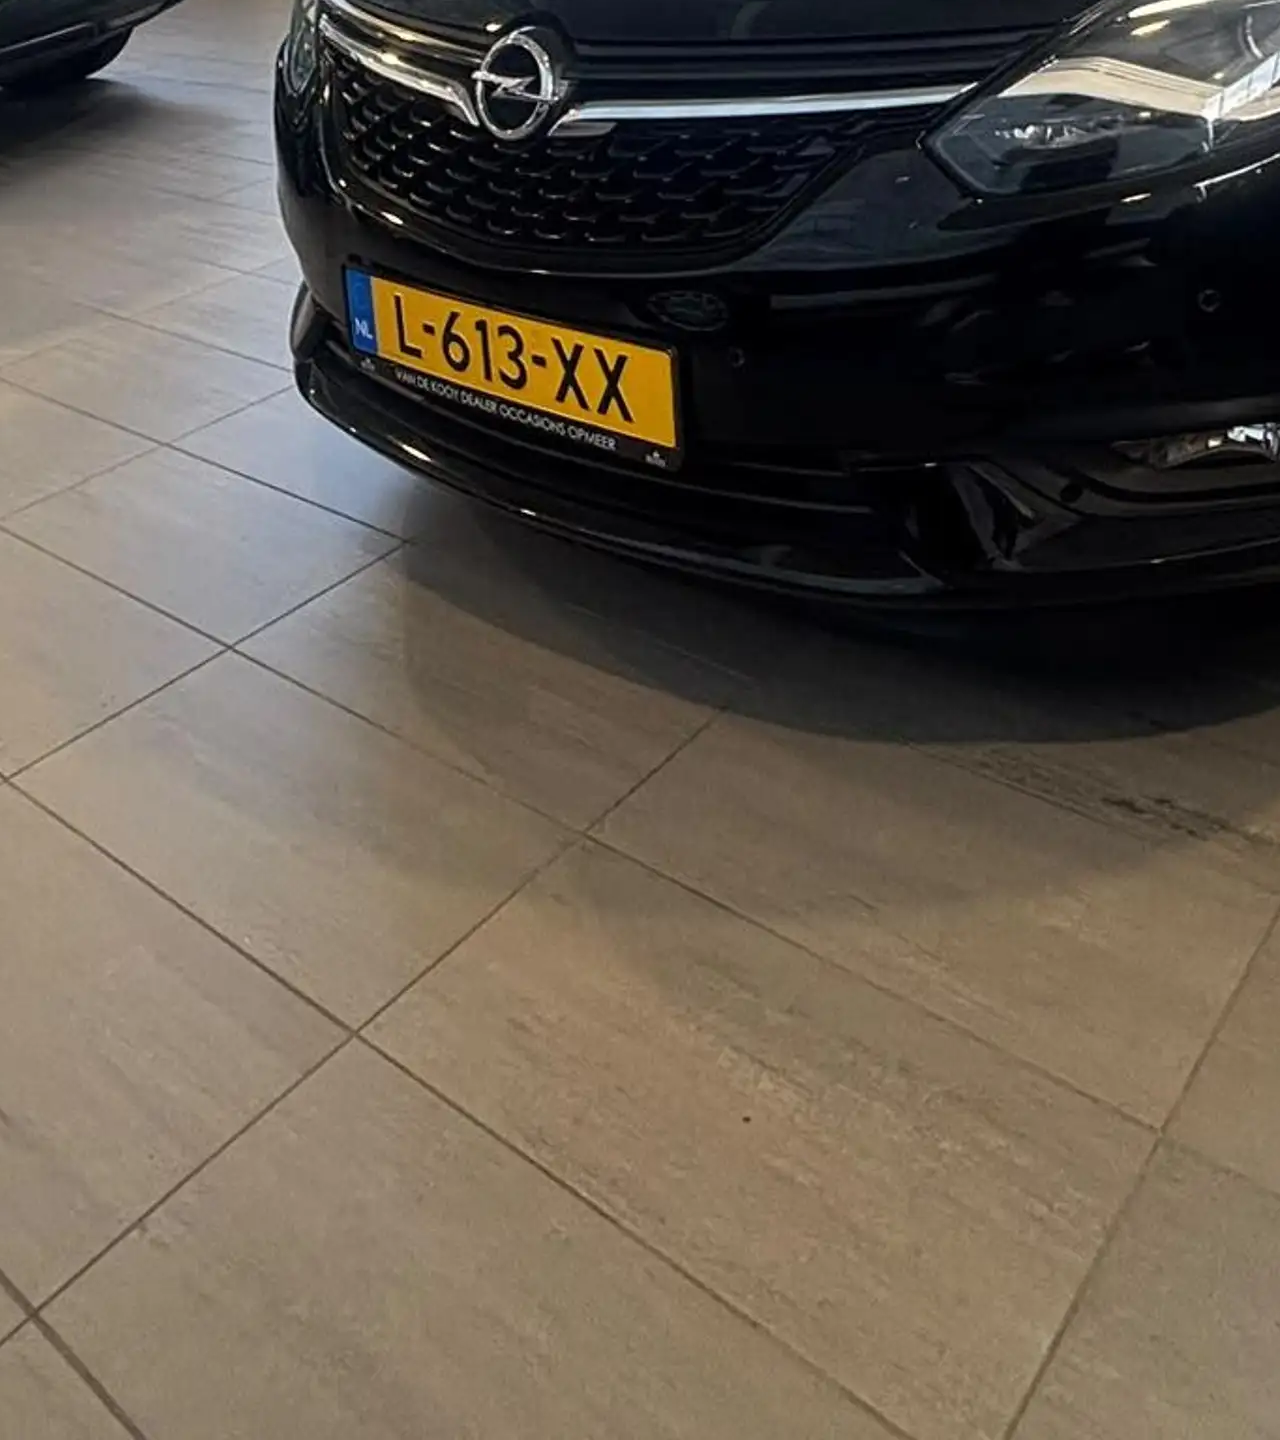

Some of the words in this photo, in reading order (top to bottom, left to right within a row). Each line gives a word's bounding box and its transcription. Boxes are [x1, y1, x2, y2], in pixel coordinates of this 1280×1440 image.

[355, 317, 373, 340] NL
[394, 294, 634, 424] L-613-XX
[460, 391, 498, 414] DEALER
[500, 404, 566, 436] OCCASIONS
